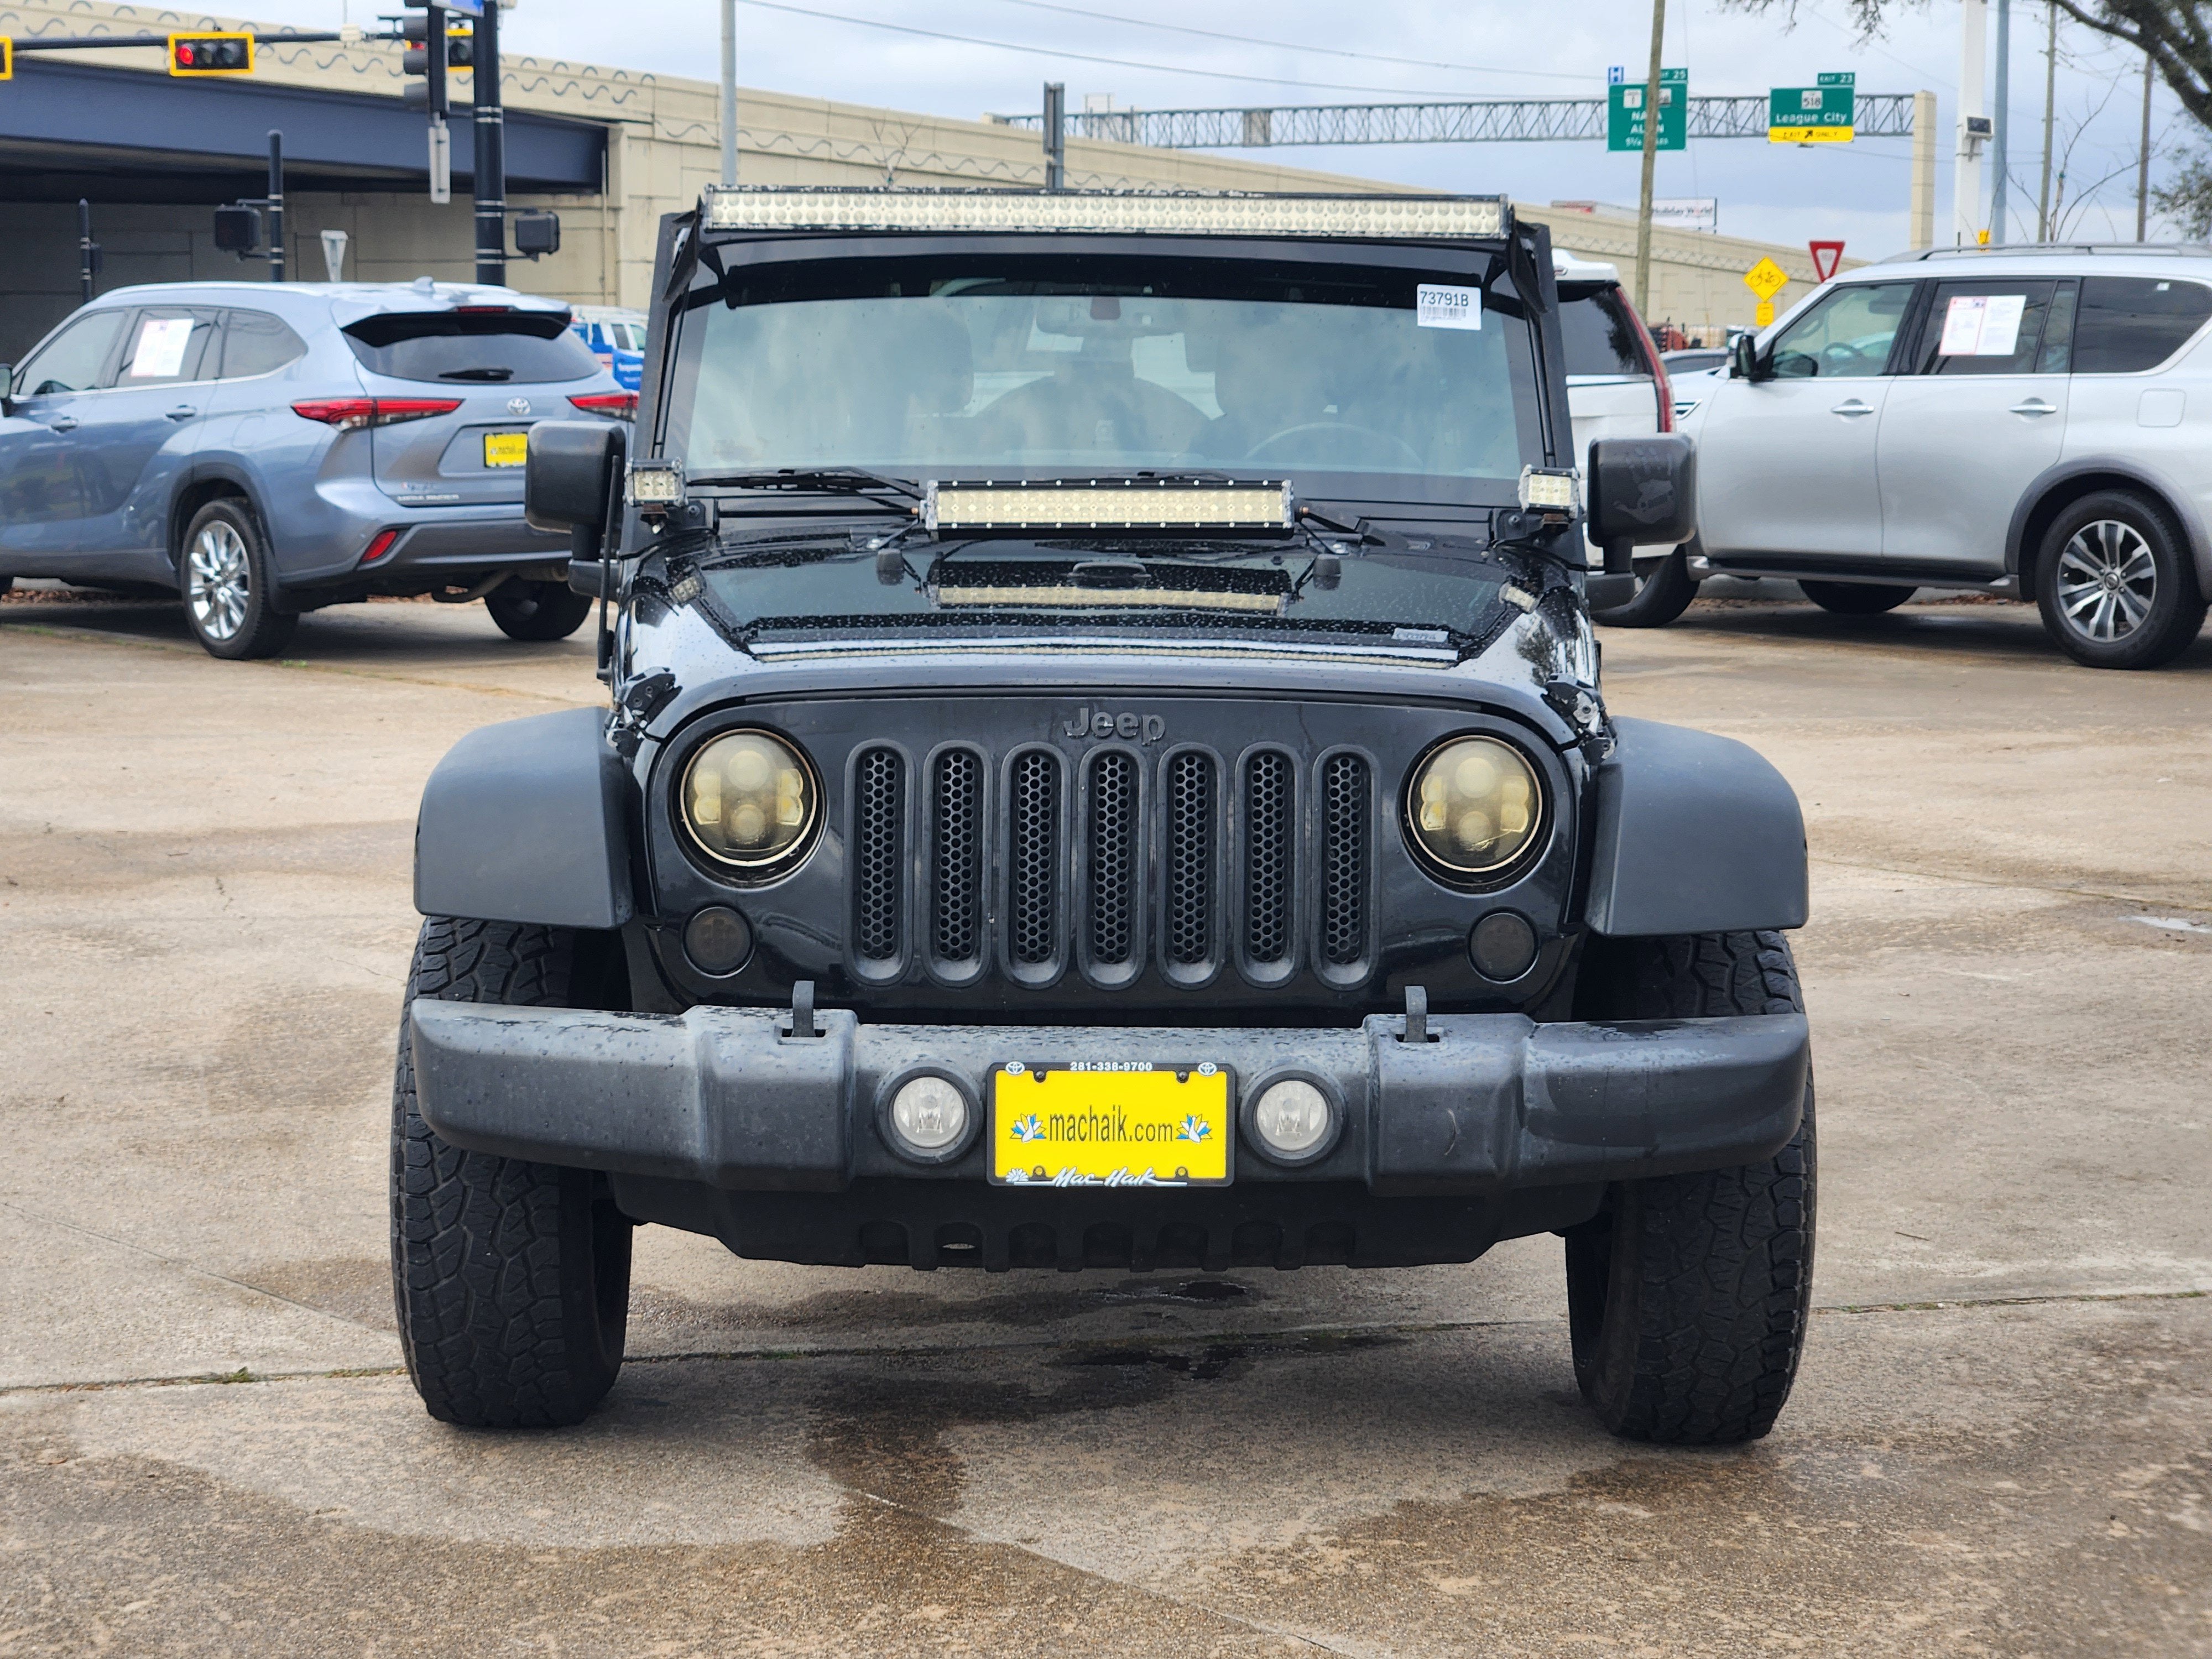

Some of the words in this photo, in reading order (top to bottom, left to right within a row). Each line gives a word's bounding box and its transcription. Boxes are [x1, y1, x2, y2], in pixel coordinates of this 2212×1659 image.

[1840, 74, 1853, 83] 23
[1803, 96, 1820, 107] 518
[1631, 111, 1662, 121] NAA
[1776, 113, 1818, 124] League
[1824, 111, 1848, 123] City
[1630, 123, 1665, 134] ALN
[1420, 291, 1469, 306] 73791B
[1063, 707, 1166, 745] Jeep
[1070, 1061, 1153, 1071] 281-338-9700
[1049, 1104, 1173, 1141] machaik.com
[1052, 1166, 1103, 1188] Mac
[1104, 1166, 1165, 1188] Haik
